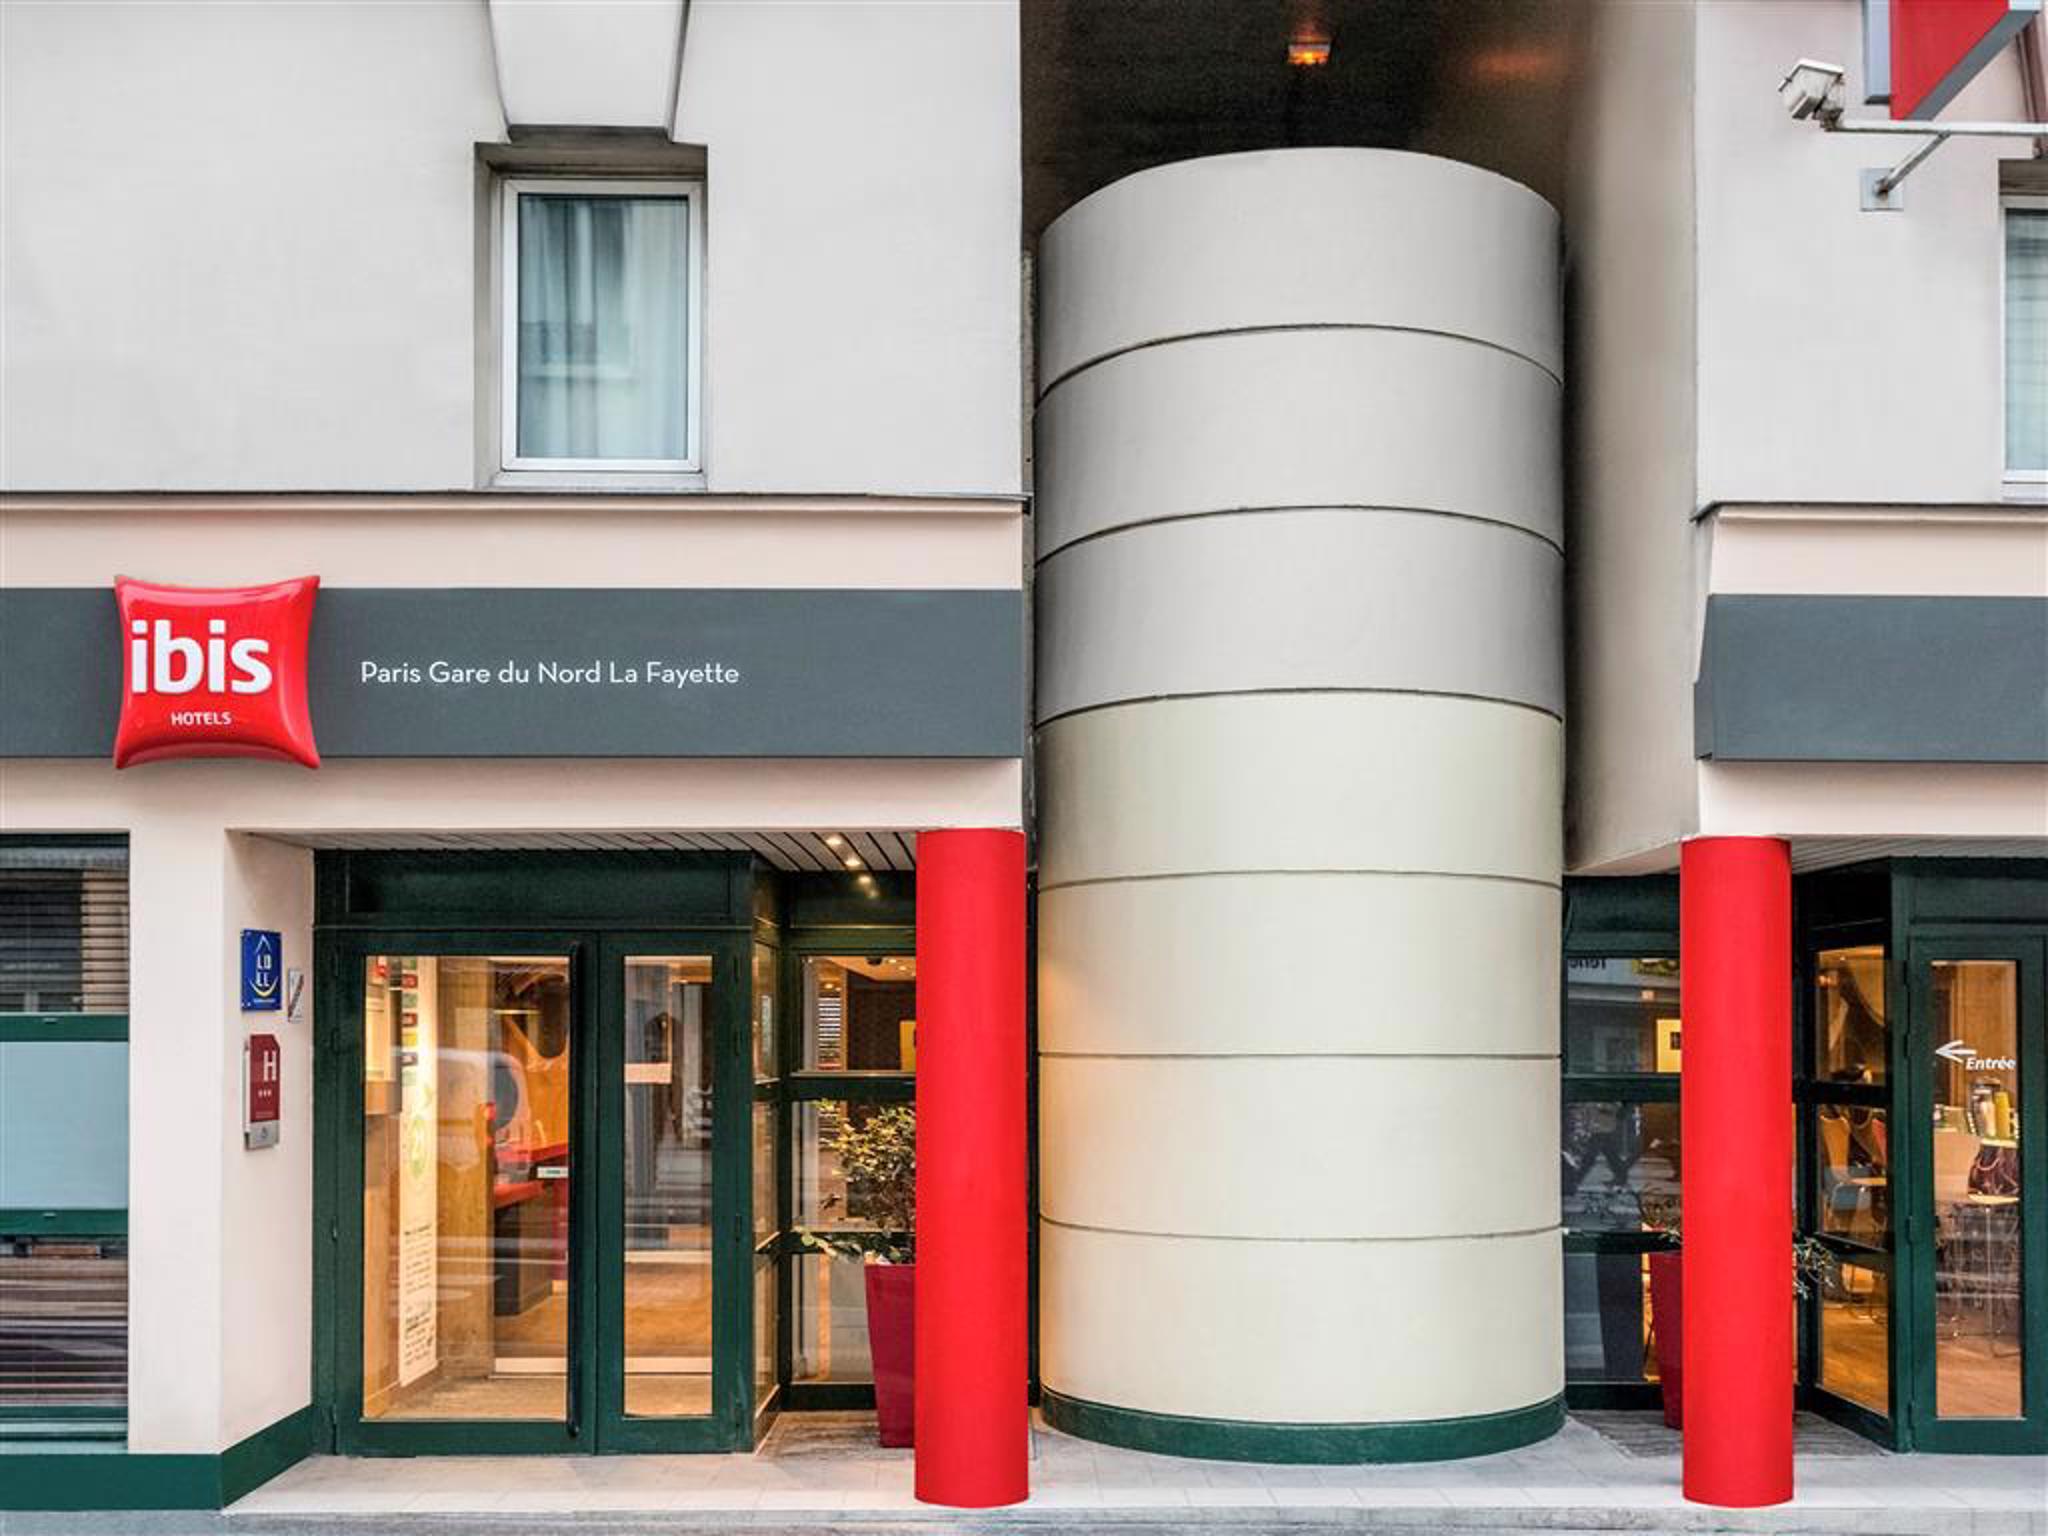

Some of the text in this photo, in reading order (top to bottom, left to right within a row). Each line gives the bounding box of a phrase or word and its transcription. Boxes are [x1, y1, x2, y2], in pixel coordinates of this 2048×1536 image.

[131, 619, 273, 694] ibis
[361, 660, 740, 689] Paris Gare du Nord La Fayette
[170, 711, 232, 726] HOTELS
[263, 1050, 277, 1082] H
[1965, 1055, 2017, 1071] Entrée
